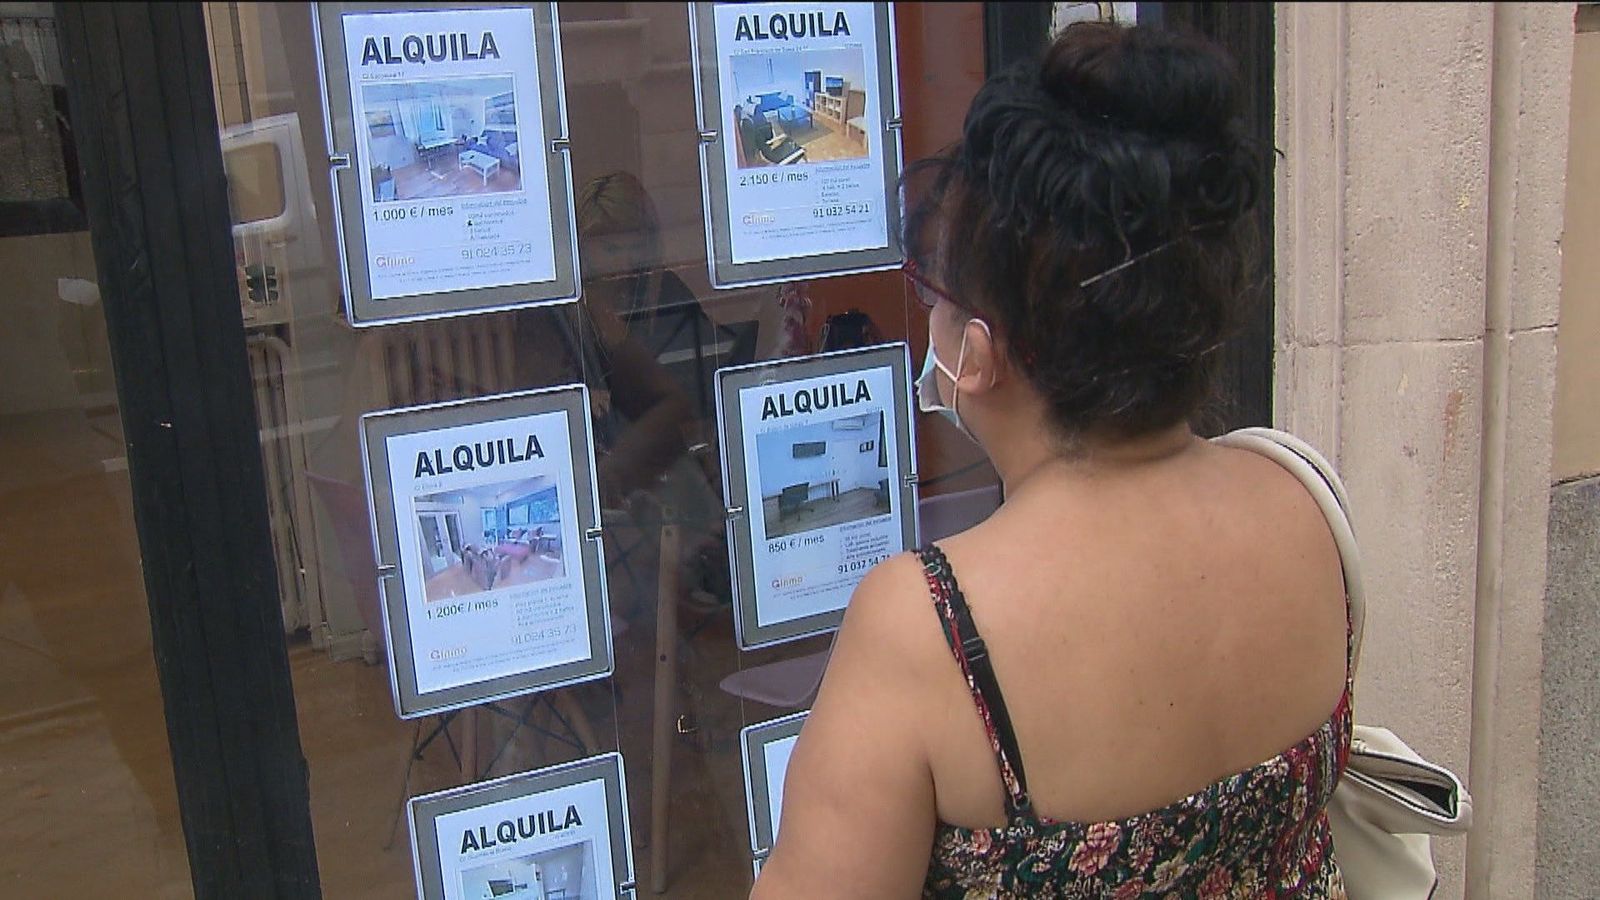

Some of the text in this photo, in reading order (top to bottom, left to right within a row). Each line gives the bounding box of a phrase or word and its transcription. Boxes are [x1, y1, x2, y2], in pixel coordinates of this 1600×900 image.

[735, 11, 851, 41] ALQUILA
[361, 31, 500, 66] ALQUILA
[739, 172, 769, 186] 2.150
[787, 170, 809, 182] mes
[373, 207, 406, 222] 1.000
[428, 206, 454, 217] mes
[761, 380, 872, 421] ALQUILA
[414, 434, 545, 479] ALQUILA
[768, 541, 787, 553] 850
[804, 535, 825, 547] mes
[474, 599, 499, 611] mes
[460, 804, 583, 854] ALQUILA
